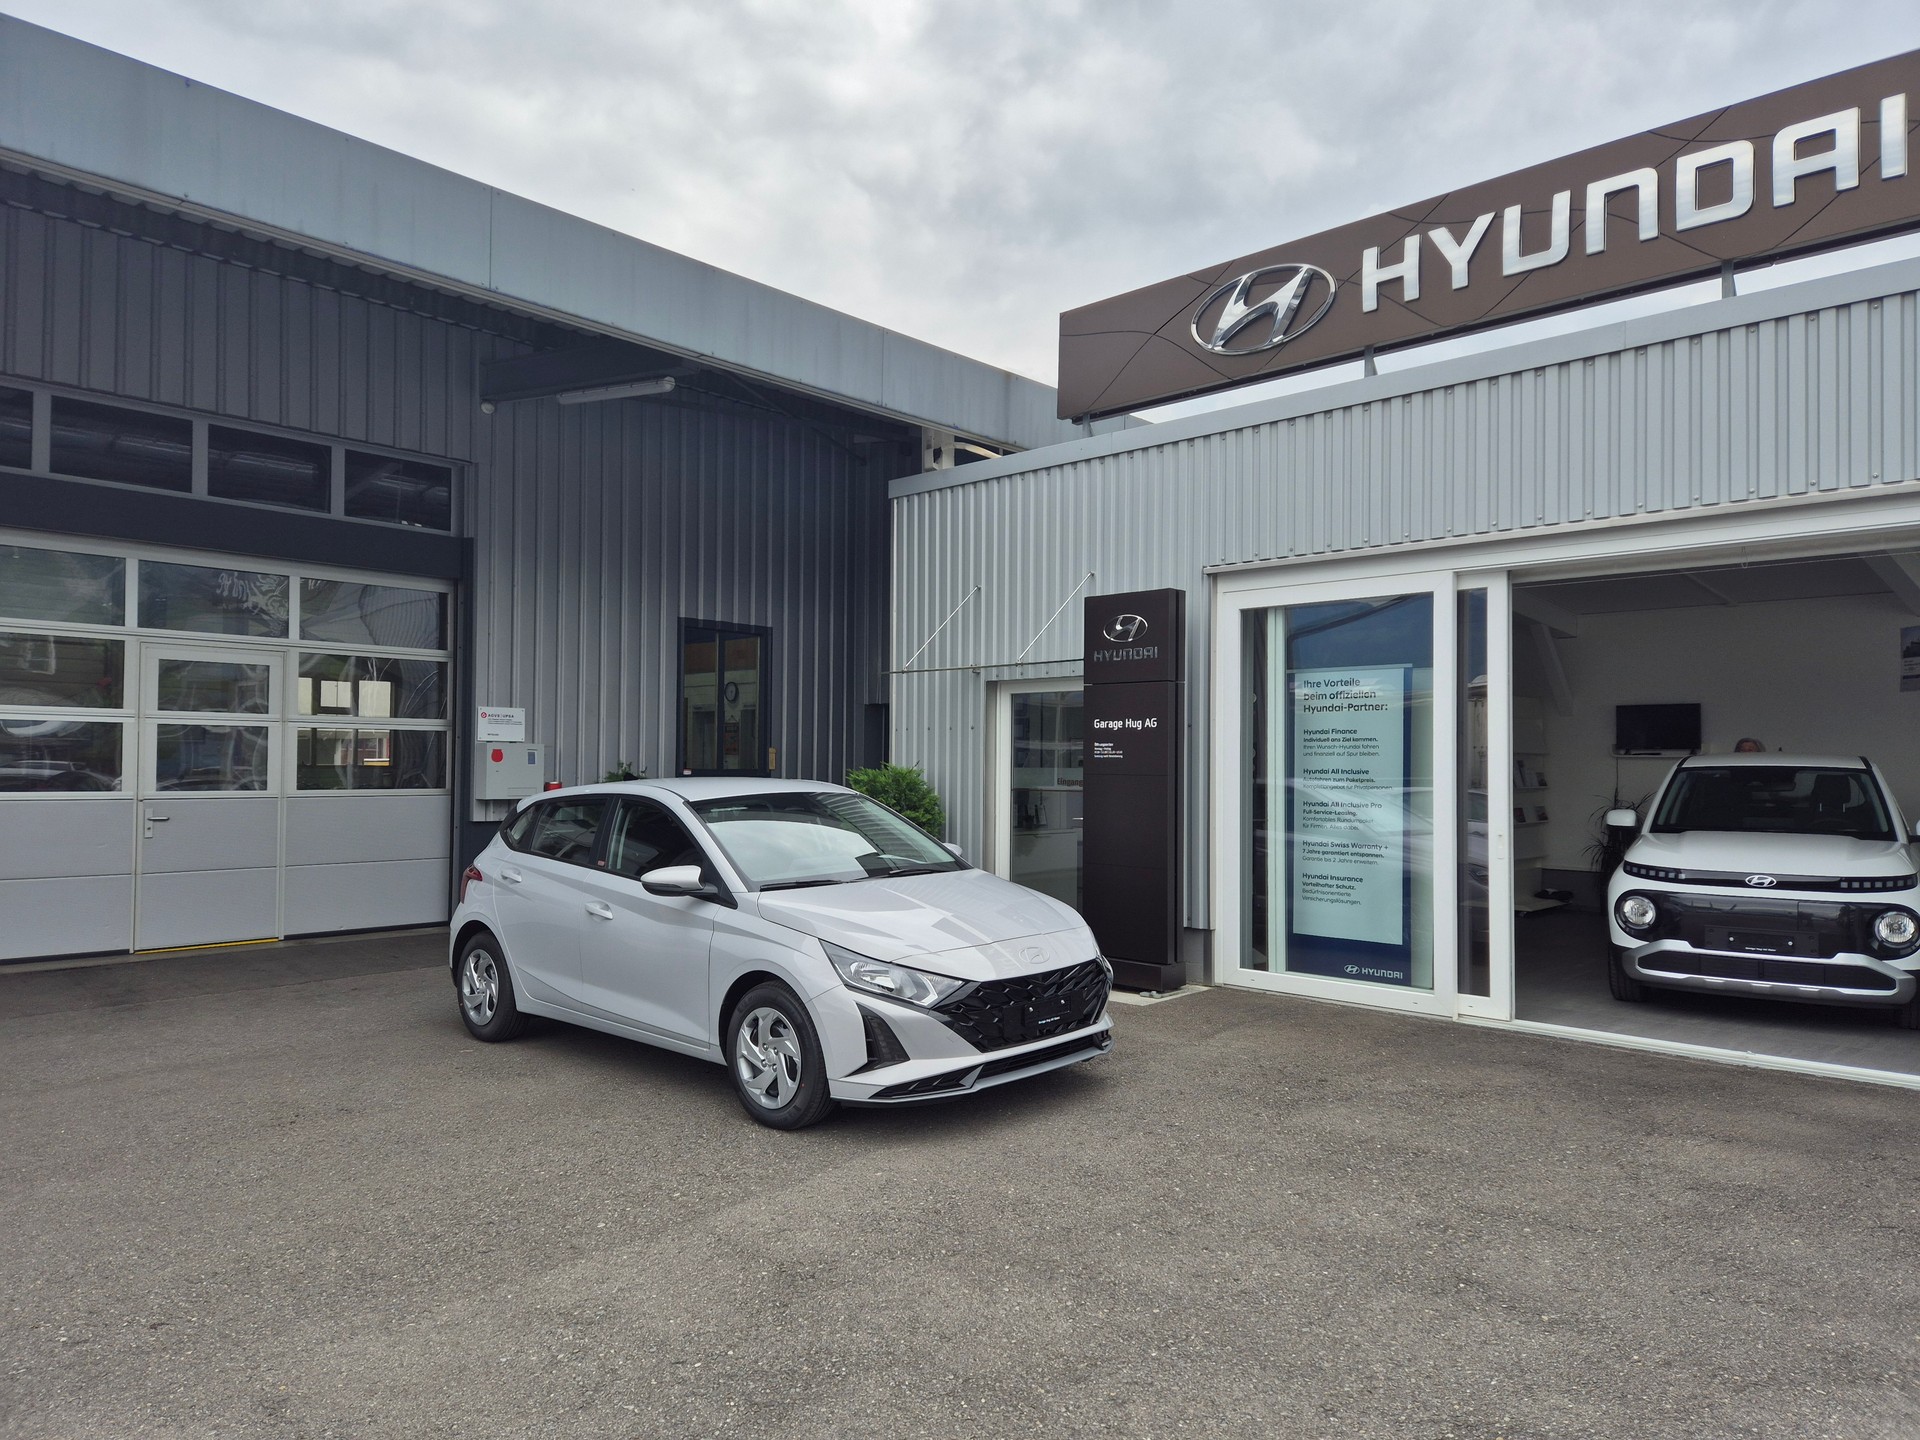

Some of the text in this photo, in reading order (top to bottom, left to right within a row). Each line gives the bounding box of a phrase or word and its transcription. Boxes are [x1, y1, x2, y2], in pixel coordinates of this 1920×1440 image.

[1361, 92, 1908, 314] HYUNDAI
[1094, 646, 1158, 662] HYUNDAI
[1304, 678, 1360, 688] Ihre Vorteile
[1304, 703, 1388, 714] Hyundai-Partner:
[1094, 718, 1157, 731] Garage Hug AG
[1362, 967, 1402, 979] HYUNDAI
